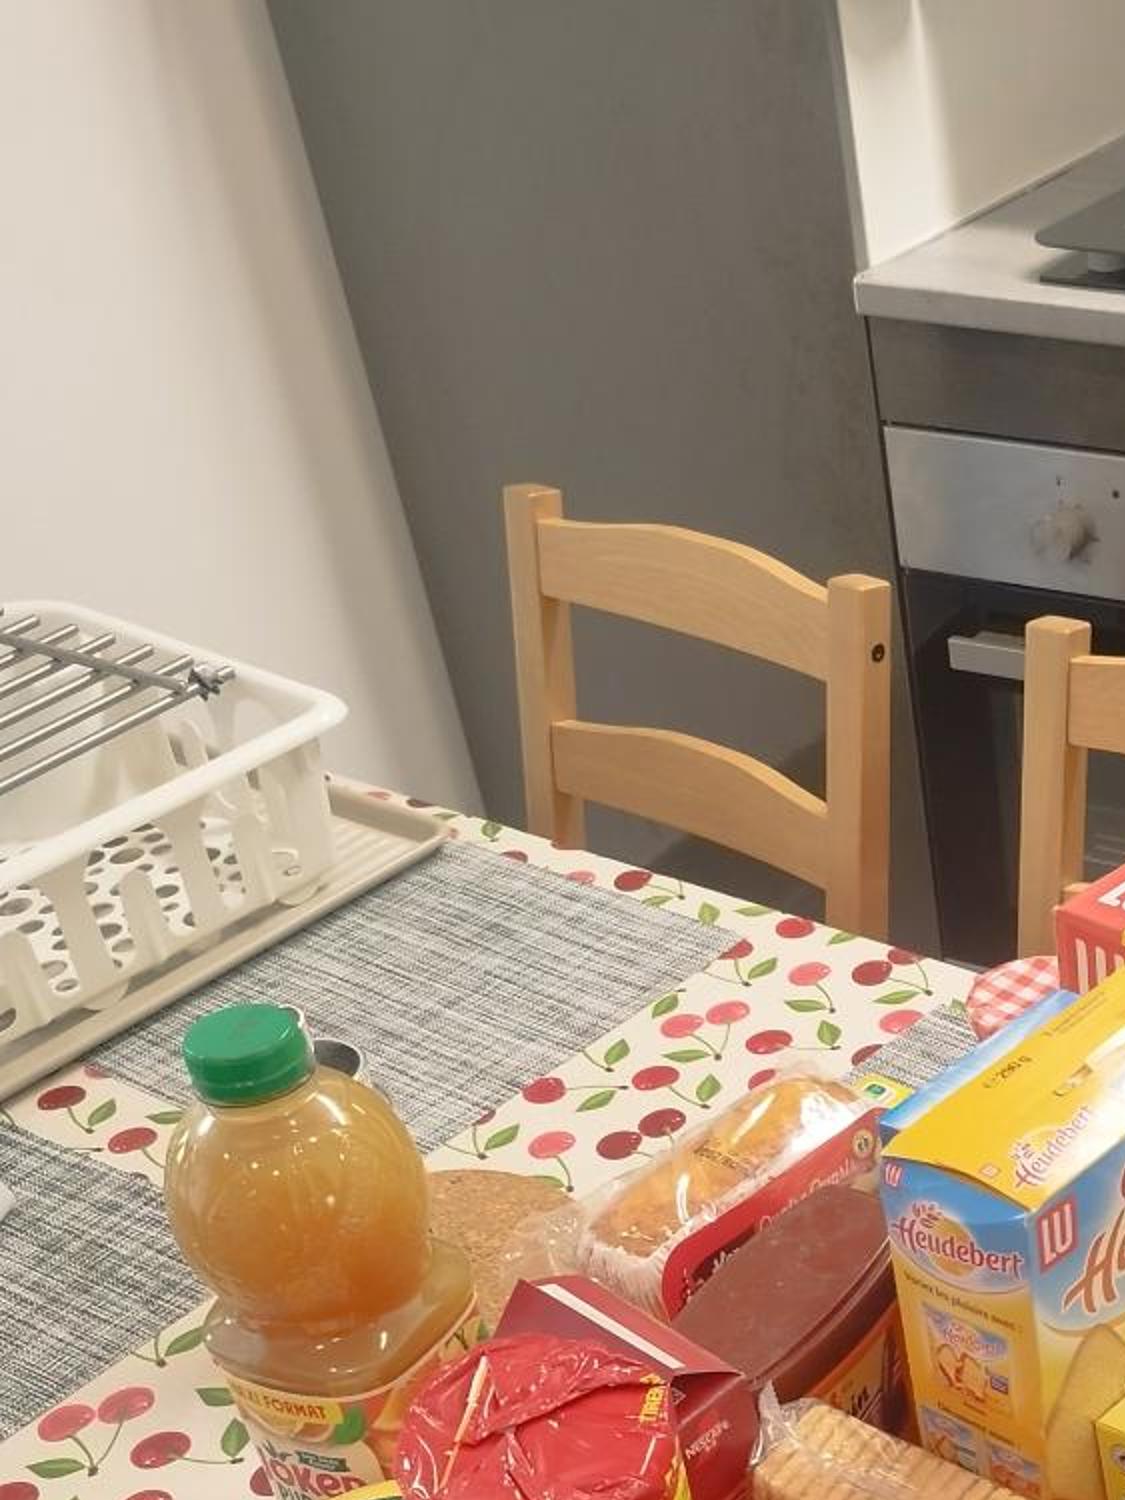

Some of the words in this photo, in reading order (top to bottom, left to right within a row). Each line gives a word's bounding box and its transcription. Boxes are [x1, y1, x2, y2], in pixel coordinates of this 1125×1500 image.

[884, 1162, 903, 1187] LU
[1014, 1104, 1091, 1189] Heudebert
[889, 1214, 1023, 1281] Heudebert
[1041, 1202, 1074, 1266] LU
